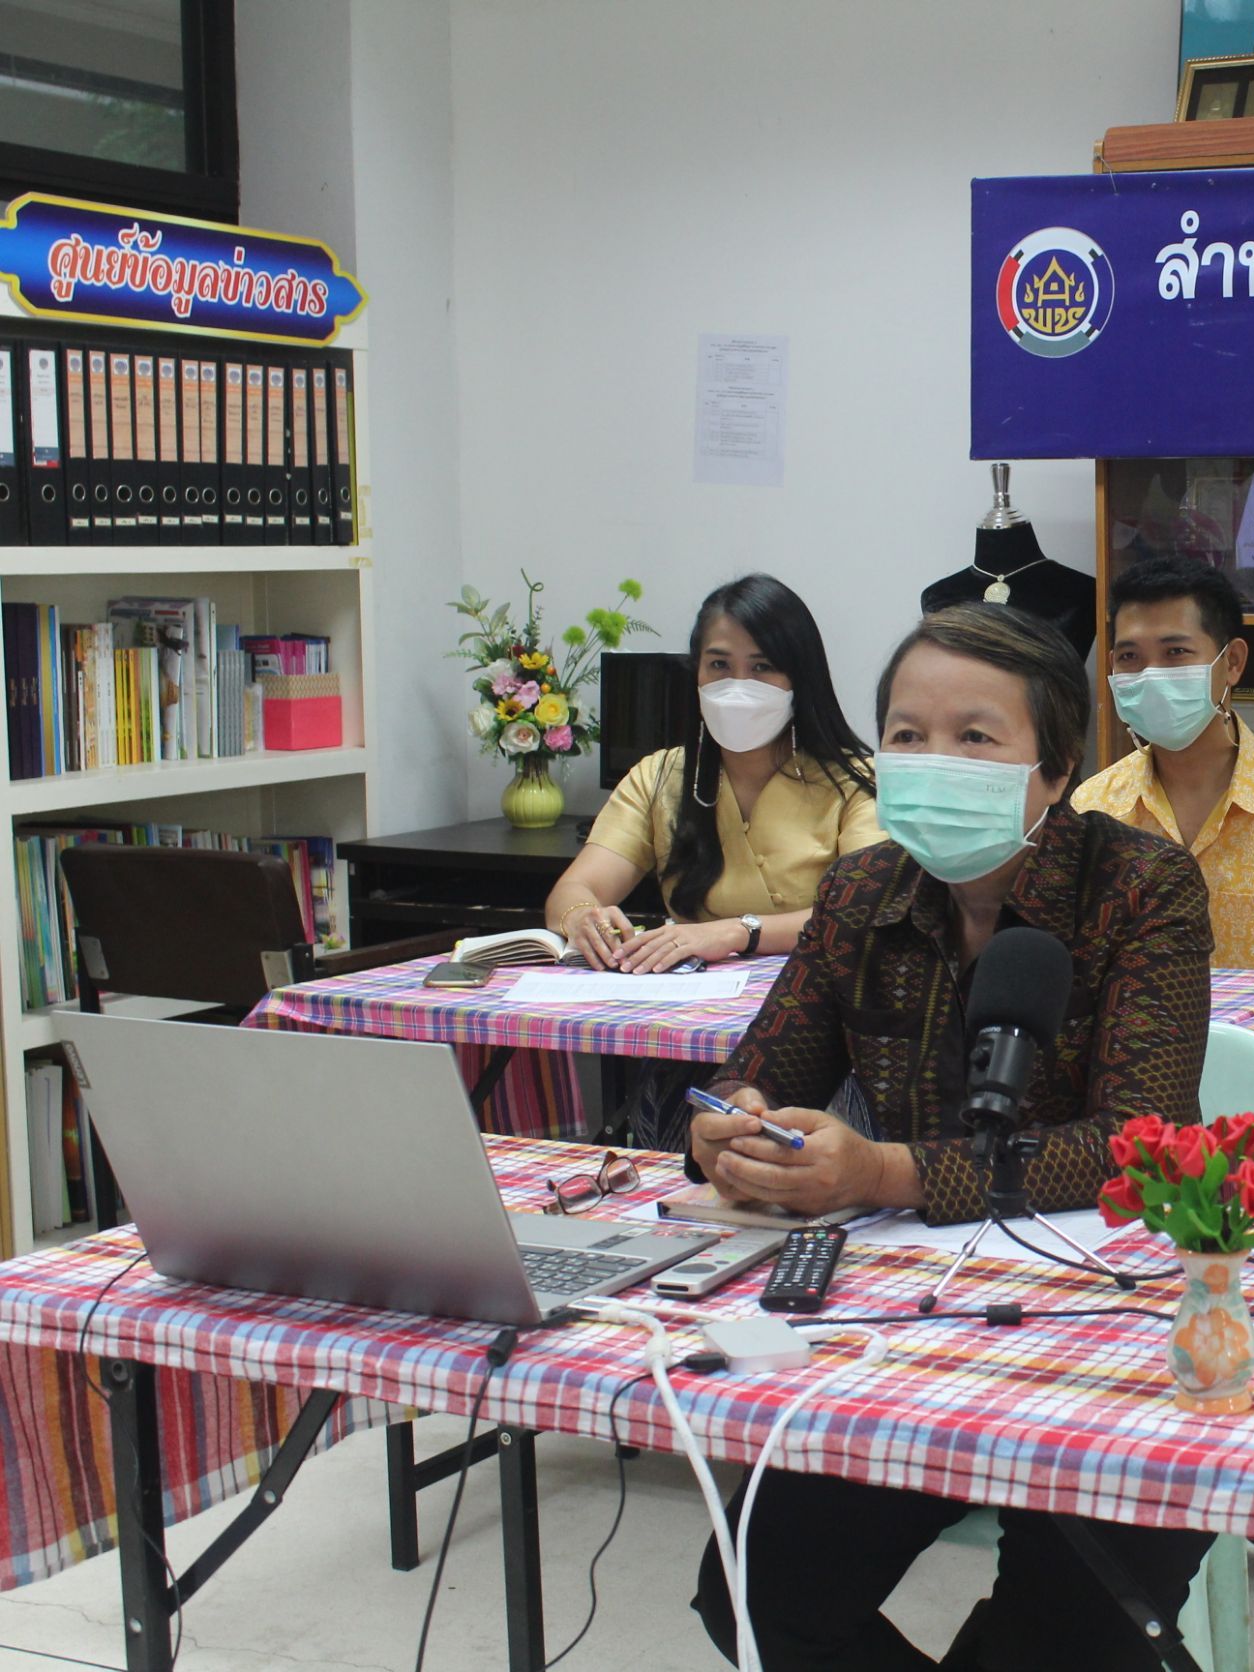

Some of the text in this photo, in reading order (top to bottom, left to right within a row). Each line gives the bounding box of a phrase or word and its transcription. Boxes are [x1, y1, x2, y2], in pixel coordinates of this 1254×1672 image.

[49, 223, 327, 318] ศูนย์ข้อมูลข่าวสาร
